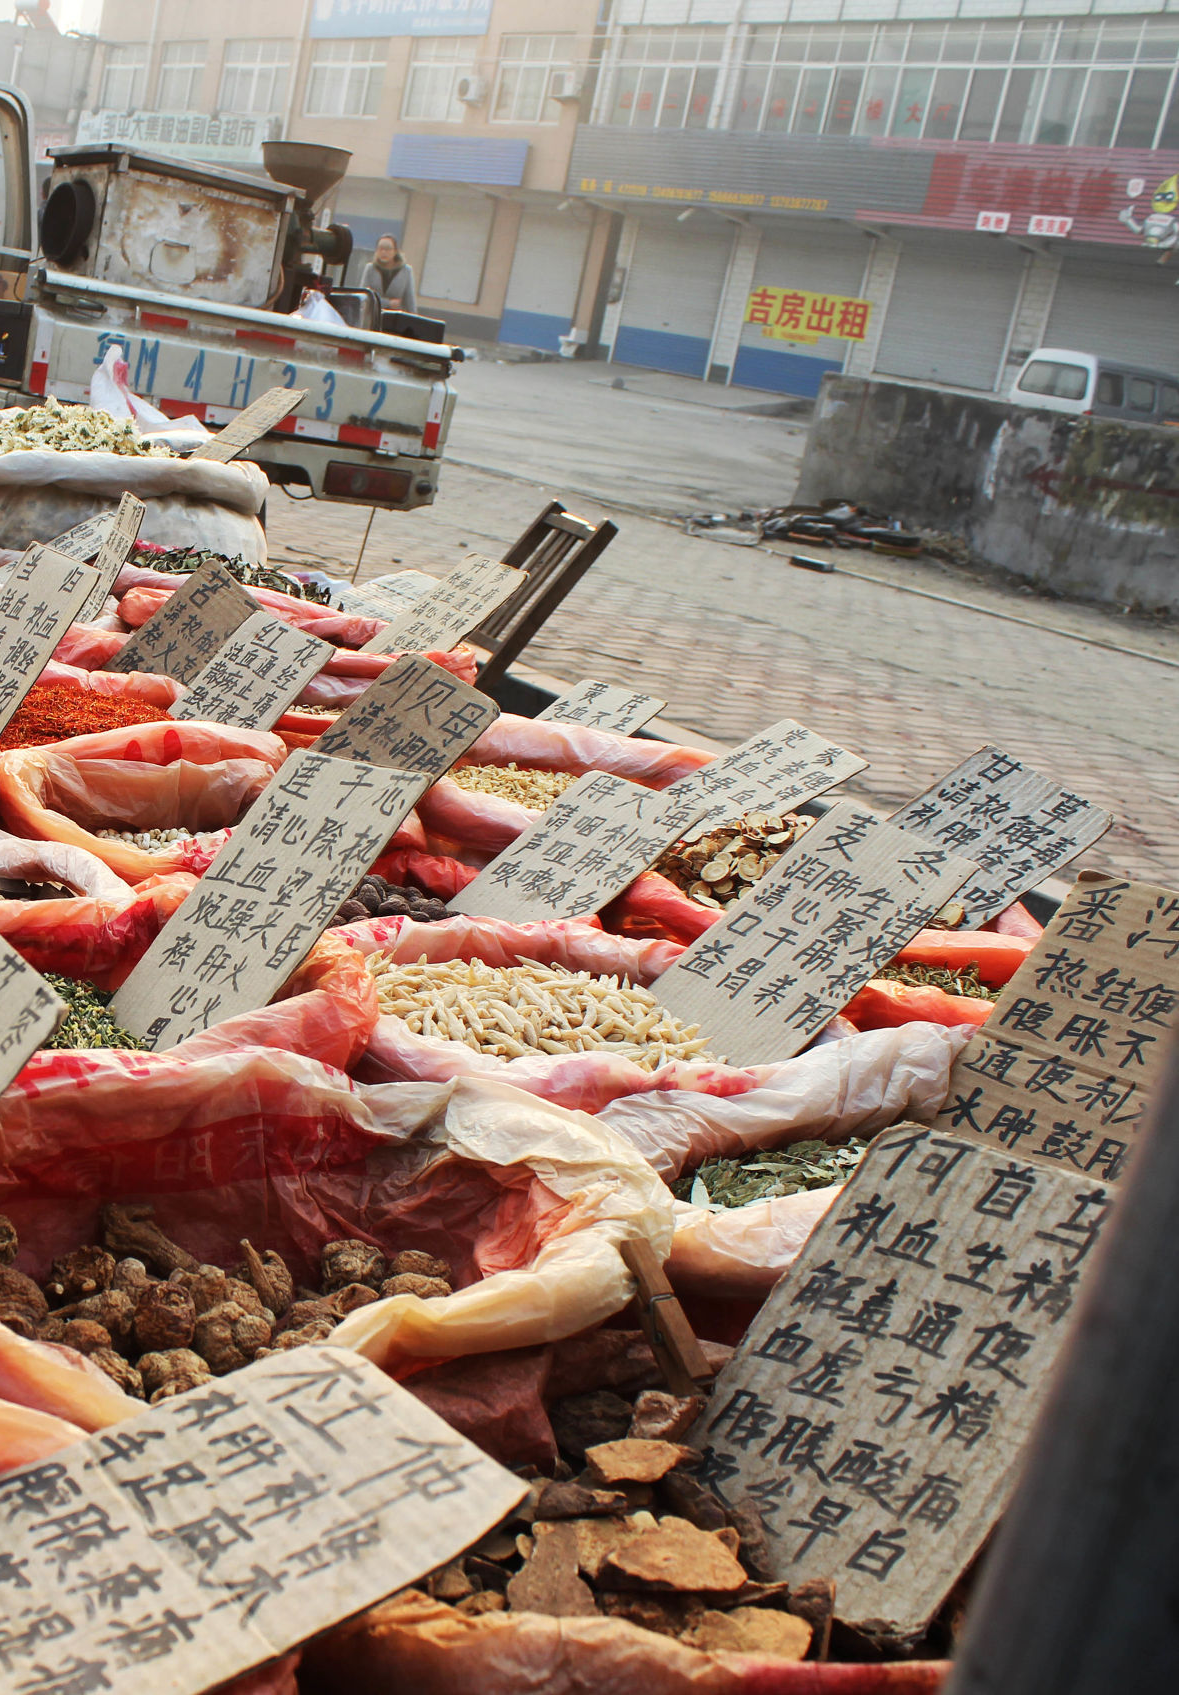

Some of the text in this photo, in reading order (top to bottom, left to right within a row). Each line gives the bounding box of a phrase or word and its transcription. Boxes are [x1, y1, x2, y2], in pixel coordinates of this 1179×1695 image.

[749, 289, 869, 339] 吉房出租
[16, 549, 85, 594] 当归
[224, 641, 299, 691] 活血通经
[251, 621, 320, 668] 红花
[379, 661, 489, 748] 川贝母
[551, 700, 637, 732] 气血不足
[578, 682, 651, 716] 黄芪
[348, 700, 448, 776] 清热润肺
[750, 739, 835, 792] 补气益脾
[784, 727, 844, 769] 党参
[279, 754, 422, 816] 莲子芯
[577, 774, 695, 833] 胖大海
[720, 751, 806, 803] 养血生津
[978, 753, 1090, 826] 甘草
[250, 795, 383, 876] 清心除热
[543, 802, 669, 863] 清咽利喉
[816, 813, 949, 885] 麦冬
[899, 801, 1035, 892] 补脾益气
[938, 778, 1077, 868] 清热解毒
[491, 859, 602, 916] 咳嗽痰多
[511, 832, 637, 892] 声哑肺热
[754, 882, 896, 968] 清心除烦
[781, 853, 940, 948] 润肺生津
[678, 939, 838, 1035] 益胃养阴
[726, 910, 871, 1000] 口干肺热
[169, 985, 221, 1029] 心火
[998, 997, 1156, 1069] 腹胀不
[879, 1130, 1112, 1270] 何首乌
[835, 1193, 1081, 1323] 补血生精
[791, 1260, 1037, 1388] 解毒通便
[254, 1352, 488, 1527] 杜仲
[707, 1388, 963, 1534] 腰膝酸痛
[85, 1430, 291, 1627] 手足麻木
